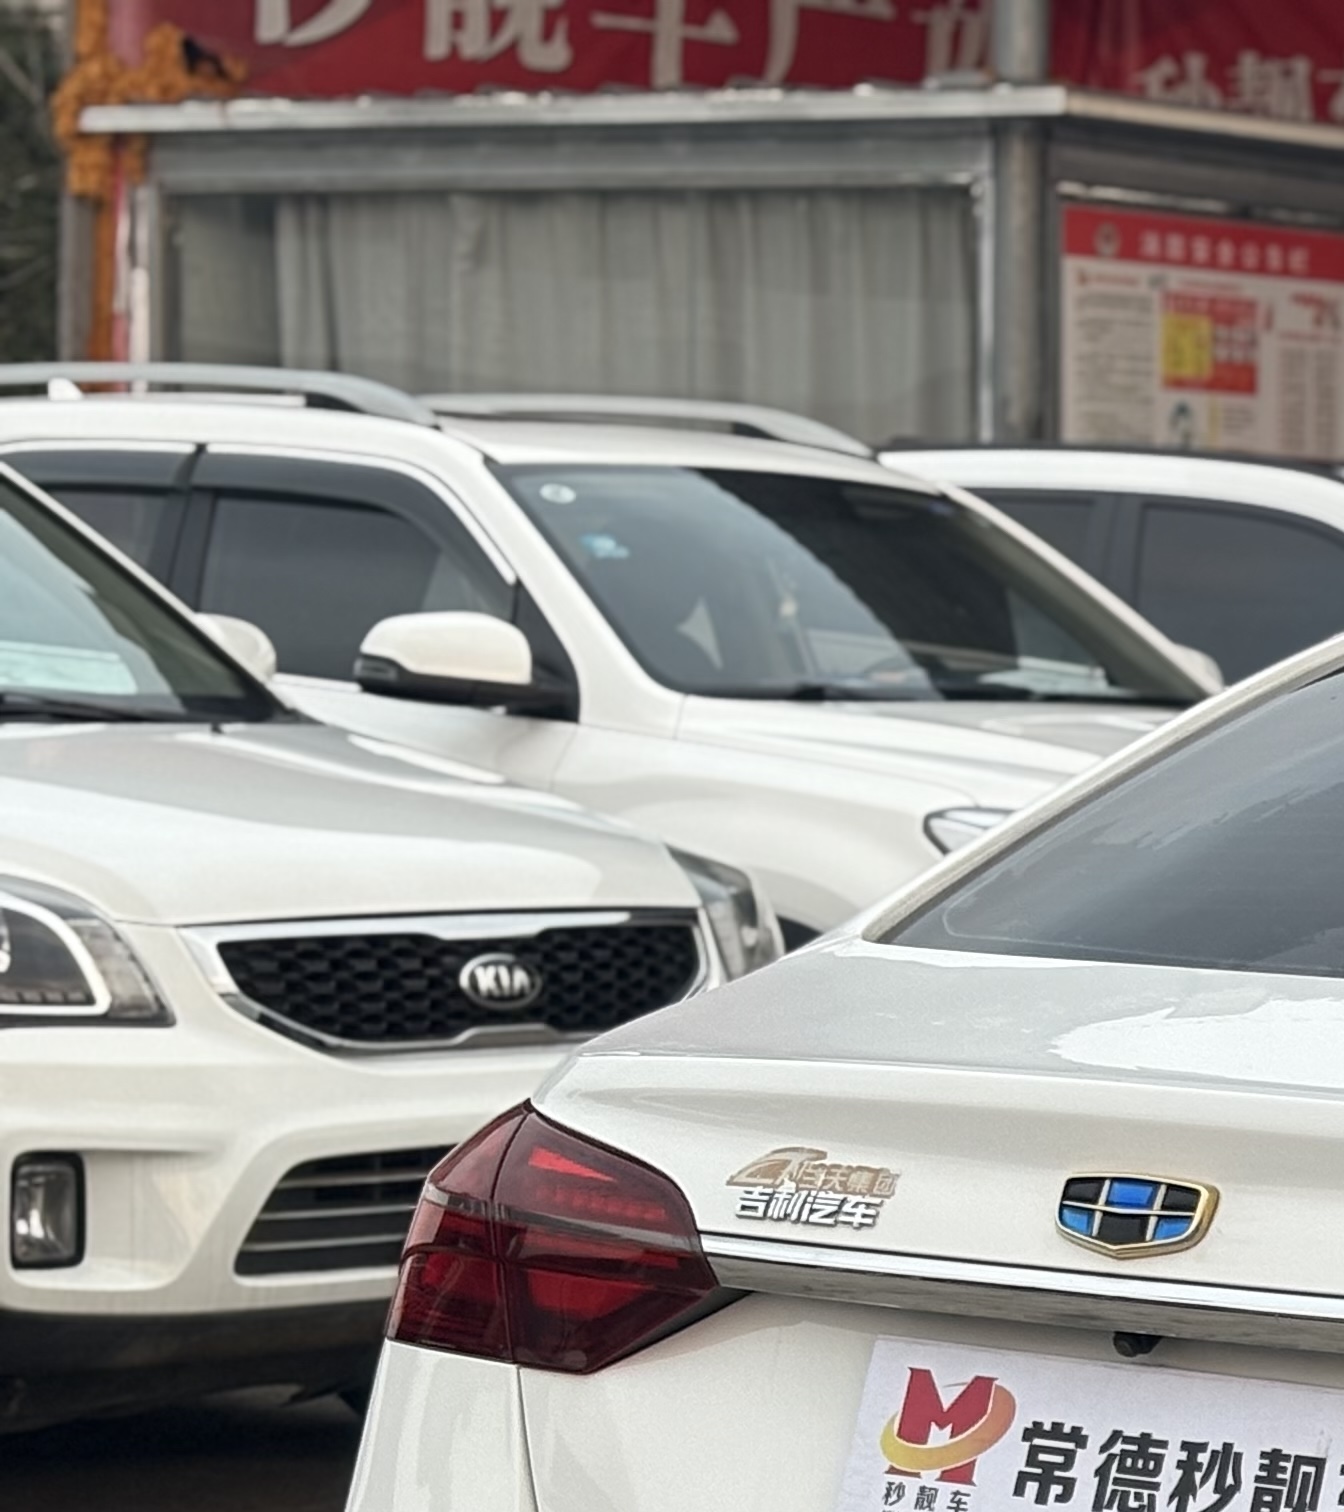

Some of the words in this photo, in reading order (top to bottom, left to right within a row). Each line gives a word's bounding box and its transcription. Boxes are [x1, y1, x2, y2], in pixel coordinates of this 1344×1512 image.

[474, 964, 531, 997] KIA
[735, 1186, 885, 1230] 吉利汽车
